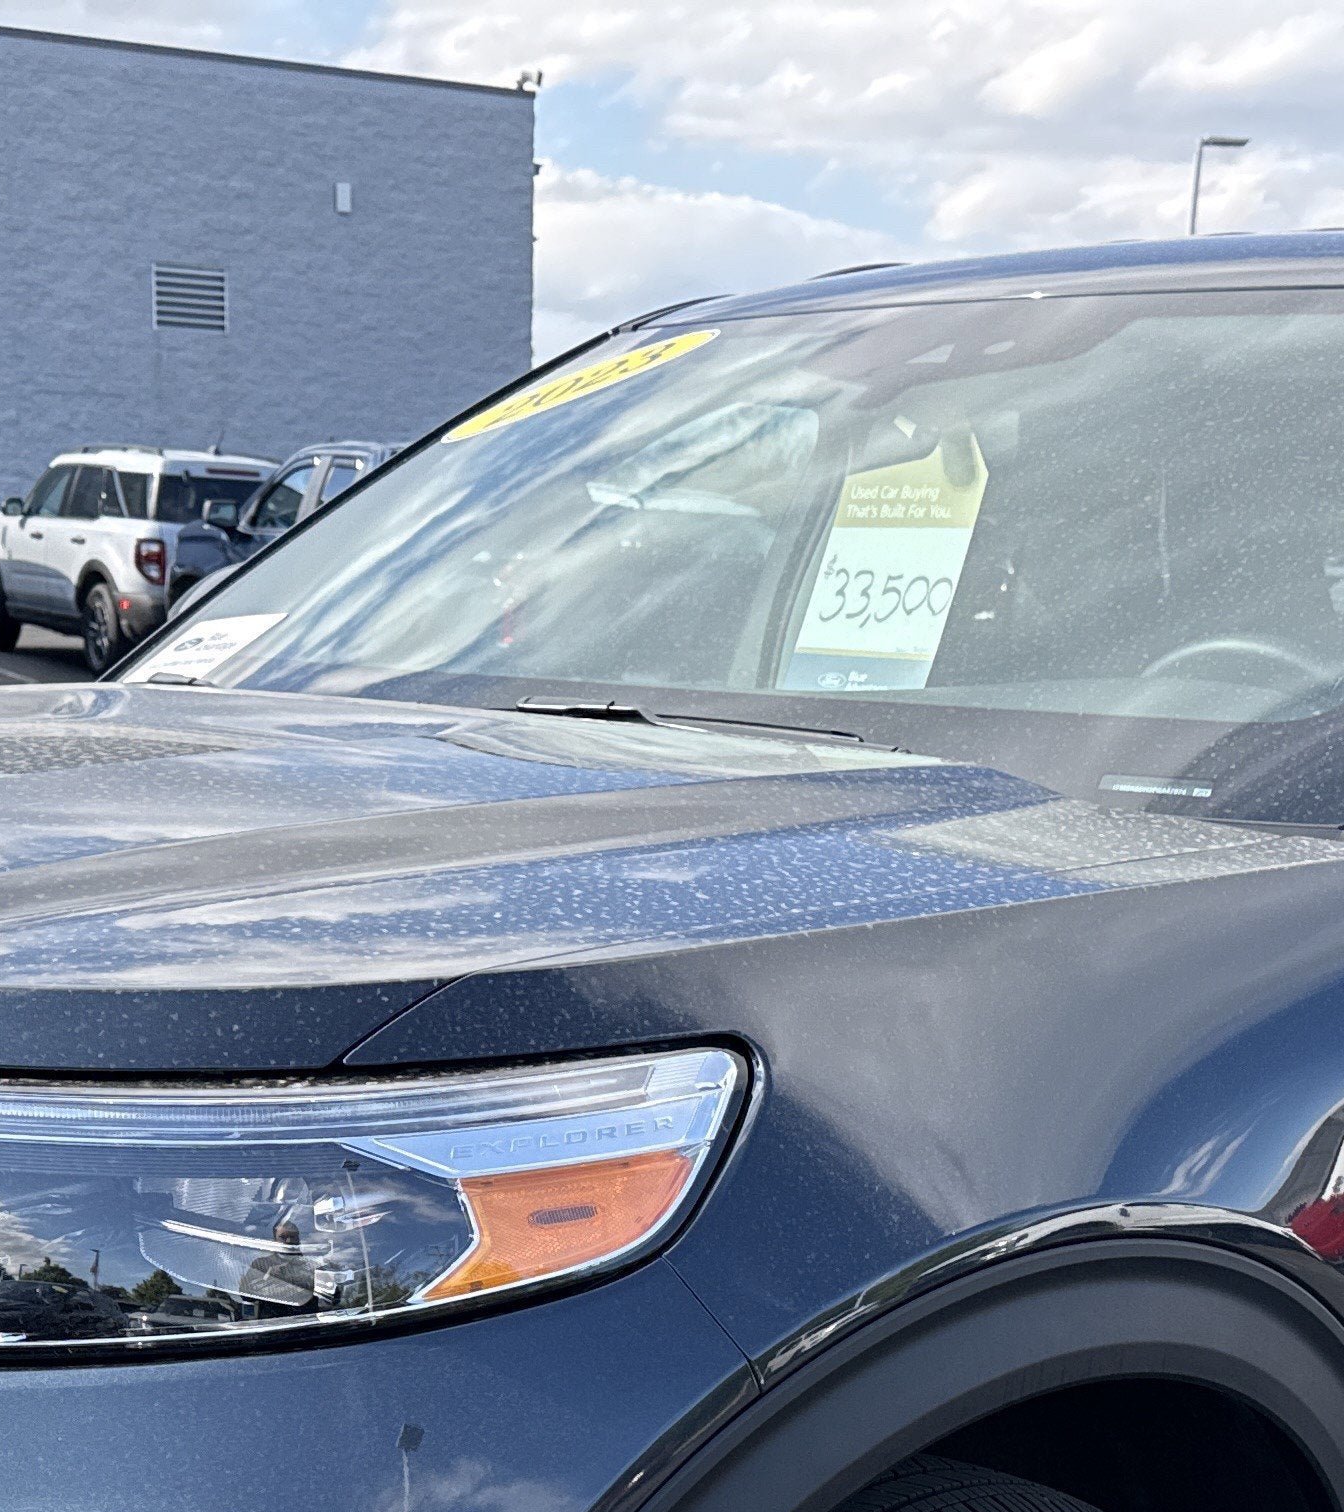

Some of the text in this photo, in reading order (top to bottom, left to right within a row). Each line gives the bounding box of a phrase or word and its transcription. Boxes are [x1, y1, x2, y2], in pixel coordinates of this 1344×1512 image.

[484, 342, 676, 429] 2023
[846, 504, 878, 518] That's
[880, 504, 905, 519] Built
[907, 505, 927, 519] For
[850, 485, 940, 502] Used Car Buying
[819, 554, 953, 629] $33,500
[450, 1115, 675, 1160] EXPLORER
